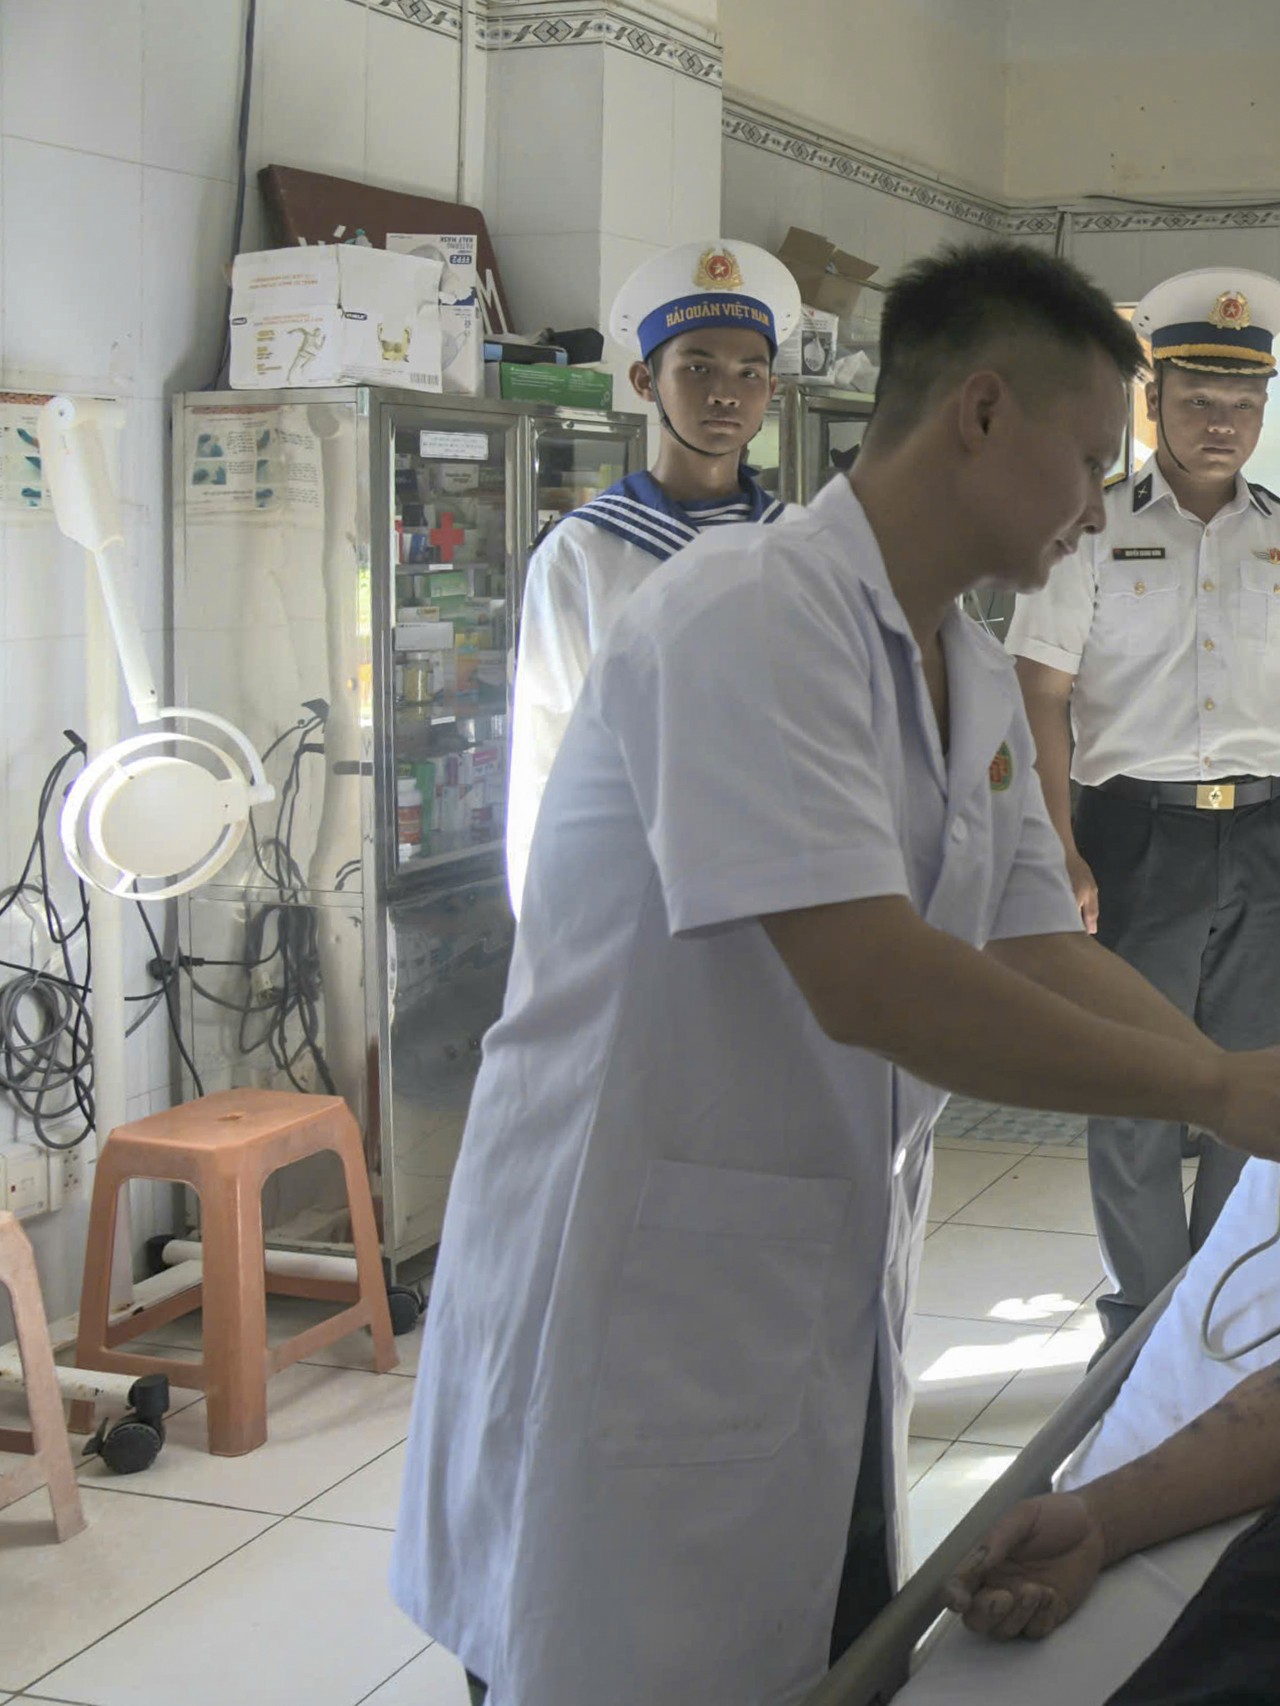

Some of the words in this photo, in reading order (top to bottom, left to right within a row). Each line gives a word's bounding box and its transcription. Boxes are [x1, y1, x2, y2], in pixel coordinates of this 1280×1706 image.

[666, 306, 684, 327] HẢI
[686, 301, 720, 319] QUÂN
[722, 301, 750, 320] VIỆT
[751, 308, 770, 326] NAM
